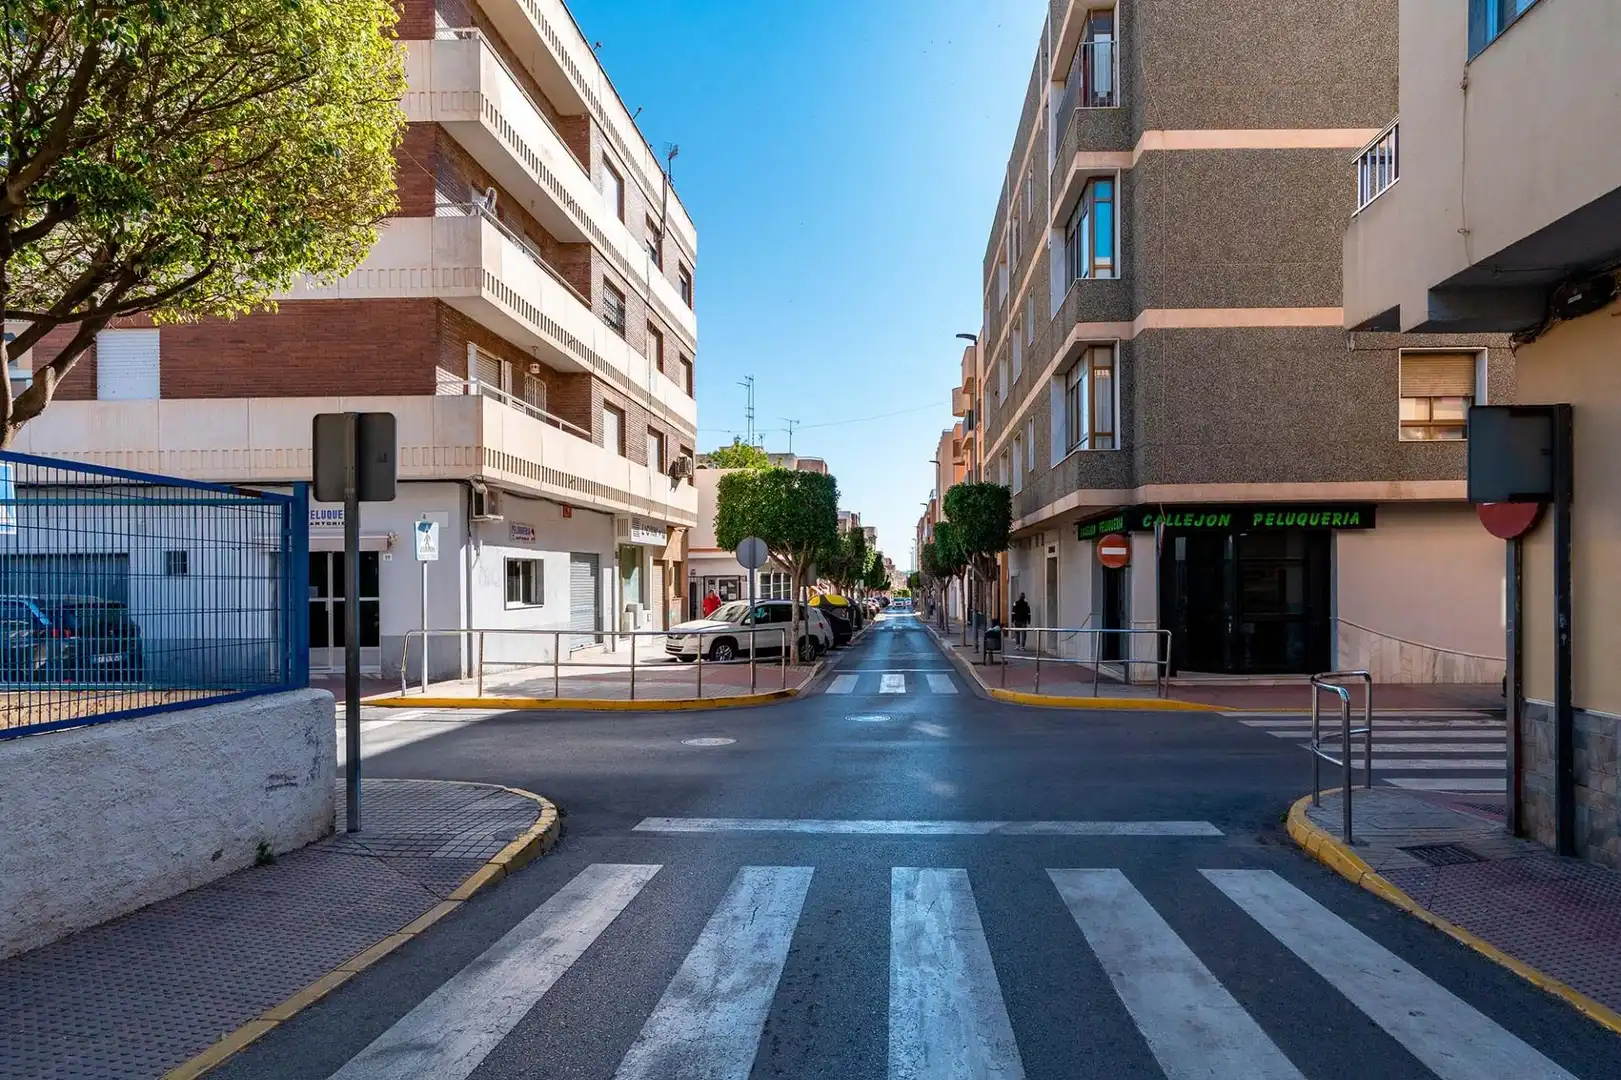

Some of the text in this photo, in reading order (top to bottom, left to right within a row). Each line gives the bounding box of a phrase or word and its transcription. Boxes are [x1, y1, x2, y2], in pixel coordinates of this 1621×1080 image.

[310, 510, 343, 520] ELUQUE
[1142, 512, 1360, 528] CALLEJON PELUQUERIA
